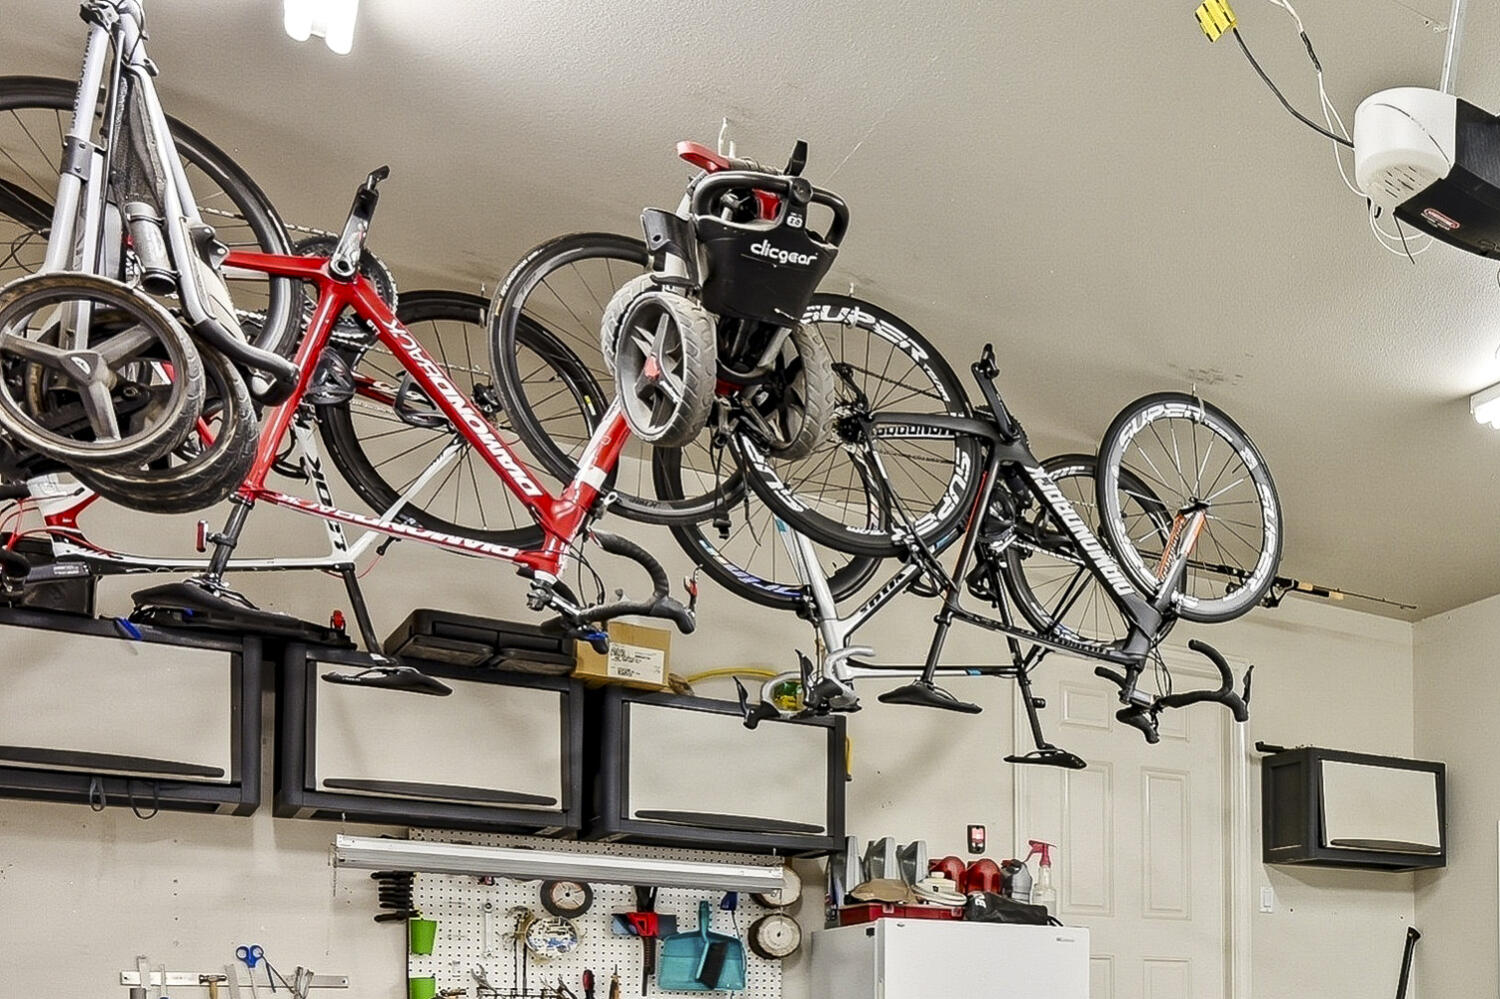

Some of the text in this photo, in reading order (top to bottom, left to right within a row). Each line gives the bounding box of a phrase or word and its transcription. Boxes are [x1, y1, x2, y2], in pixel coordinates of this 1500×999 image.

[750, 239, 818, 266] clicgear
[383, 318, 544, 497] DIAMONDBACK
[900, 446, 972, 540] SUPE
